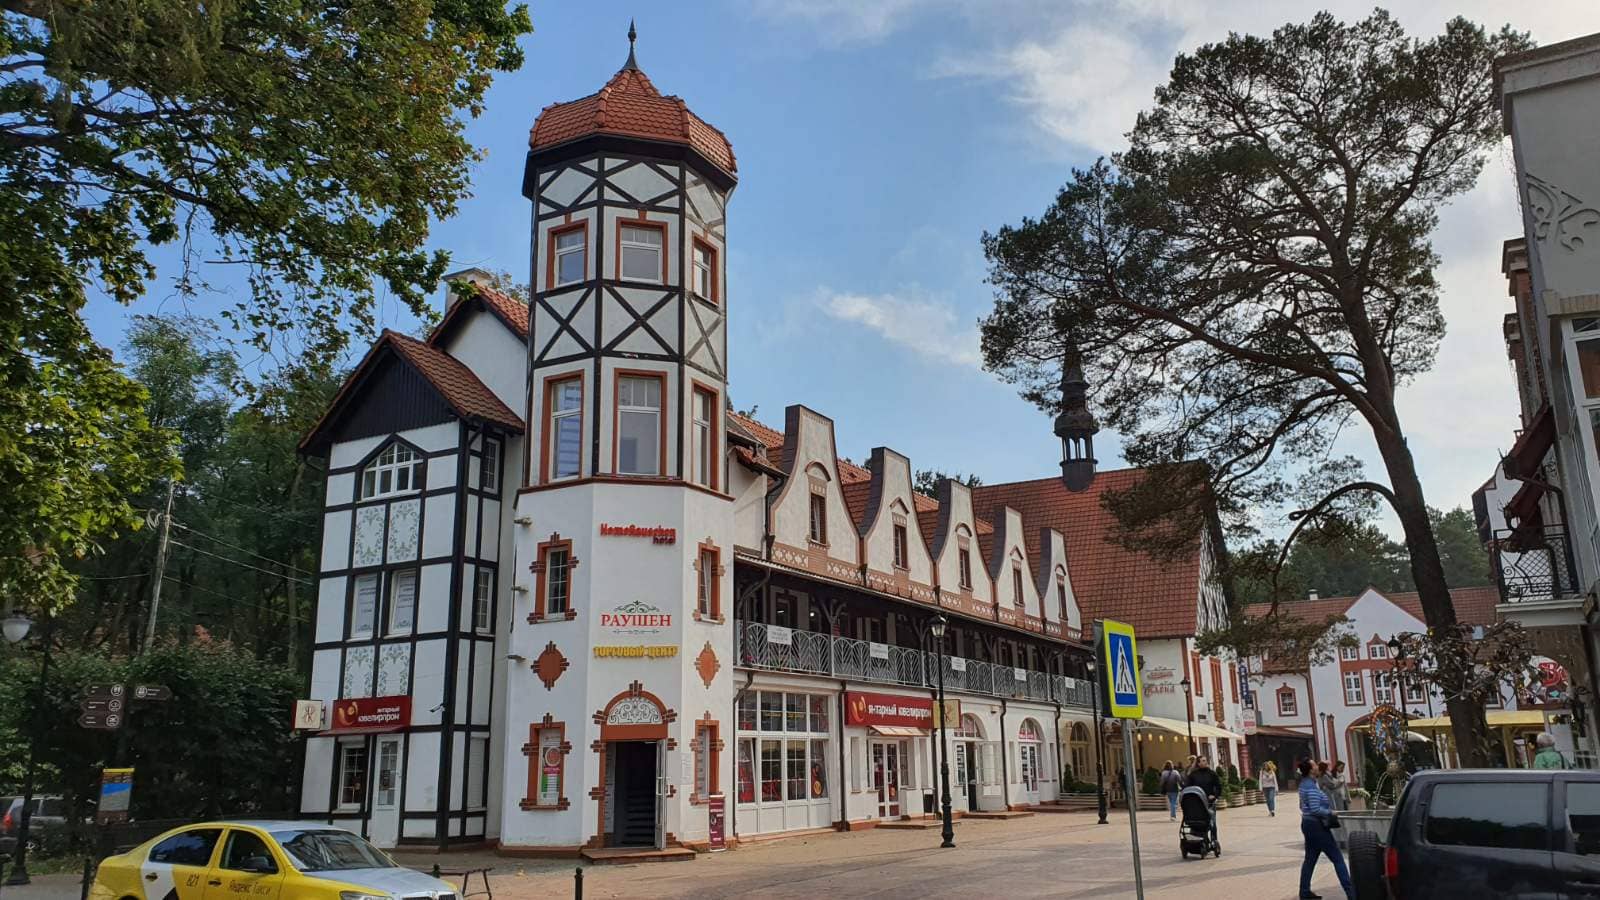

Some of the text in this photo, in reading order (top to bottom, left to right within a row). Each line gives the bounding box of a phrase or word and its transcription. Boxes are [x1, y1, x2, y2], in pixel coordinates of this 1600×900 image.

[600, 614, 672, 627] РАУШЕН
[593, 644, 679, 659] ТОРГОВЫЙ ЦЕНТР
